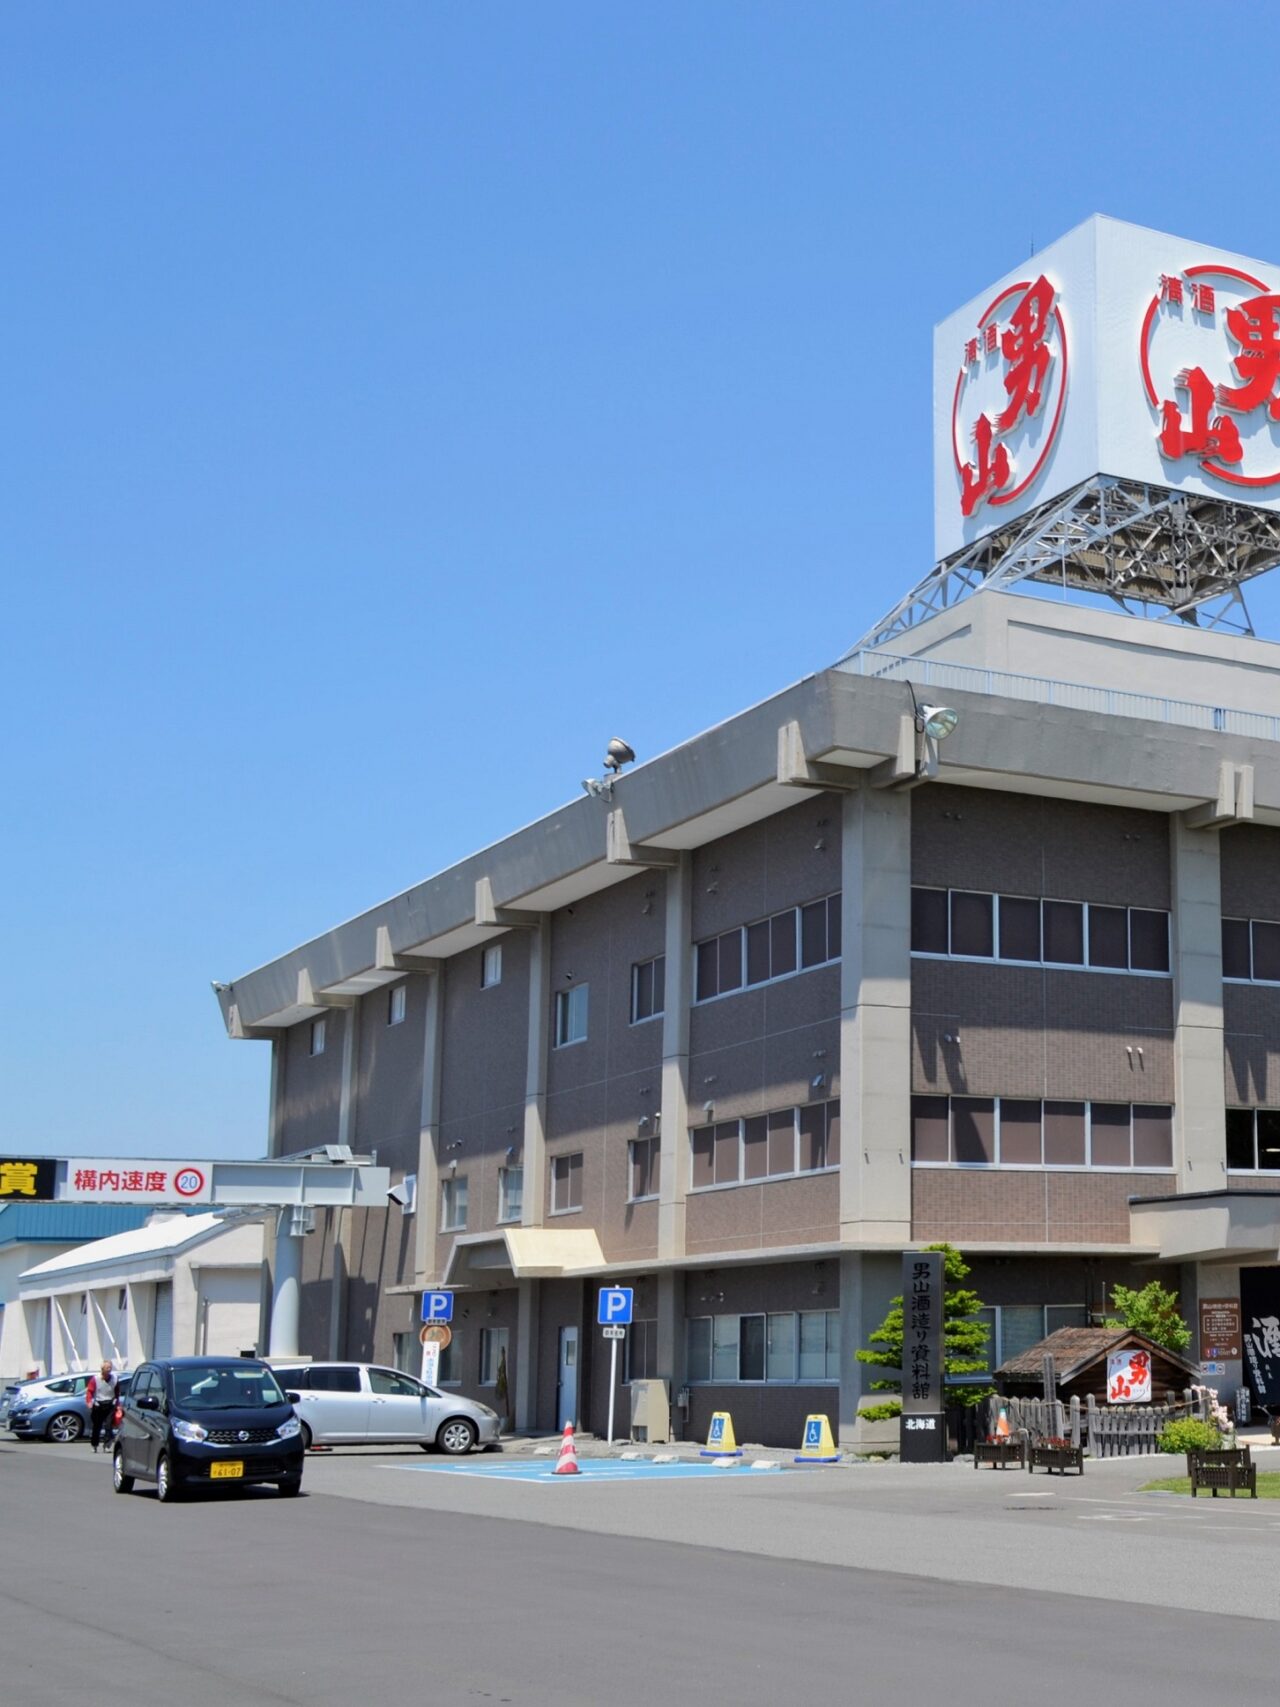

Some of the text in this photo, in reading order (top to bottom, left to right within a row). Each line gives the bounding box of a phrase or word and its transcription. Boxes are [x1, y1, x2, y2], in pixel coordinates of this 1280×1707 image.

[1159, 274, 1215, 315] 清酒
[963, 321, 1000, 364] 清酒
[960, 273, 1055, 517] 男山
[0, 1162, 38, 1196] 賞
[74, 1169, 168, 1192] 構内速度
[181, 1175, 198, 1190] 20
[429, 1294, 448, 1318] P
[607, 1291, 627, 1321] P
[1110, 1350, 1150, 1400] 男山
[905, 1418, 936, 1430] 北海道
